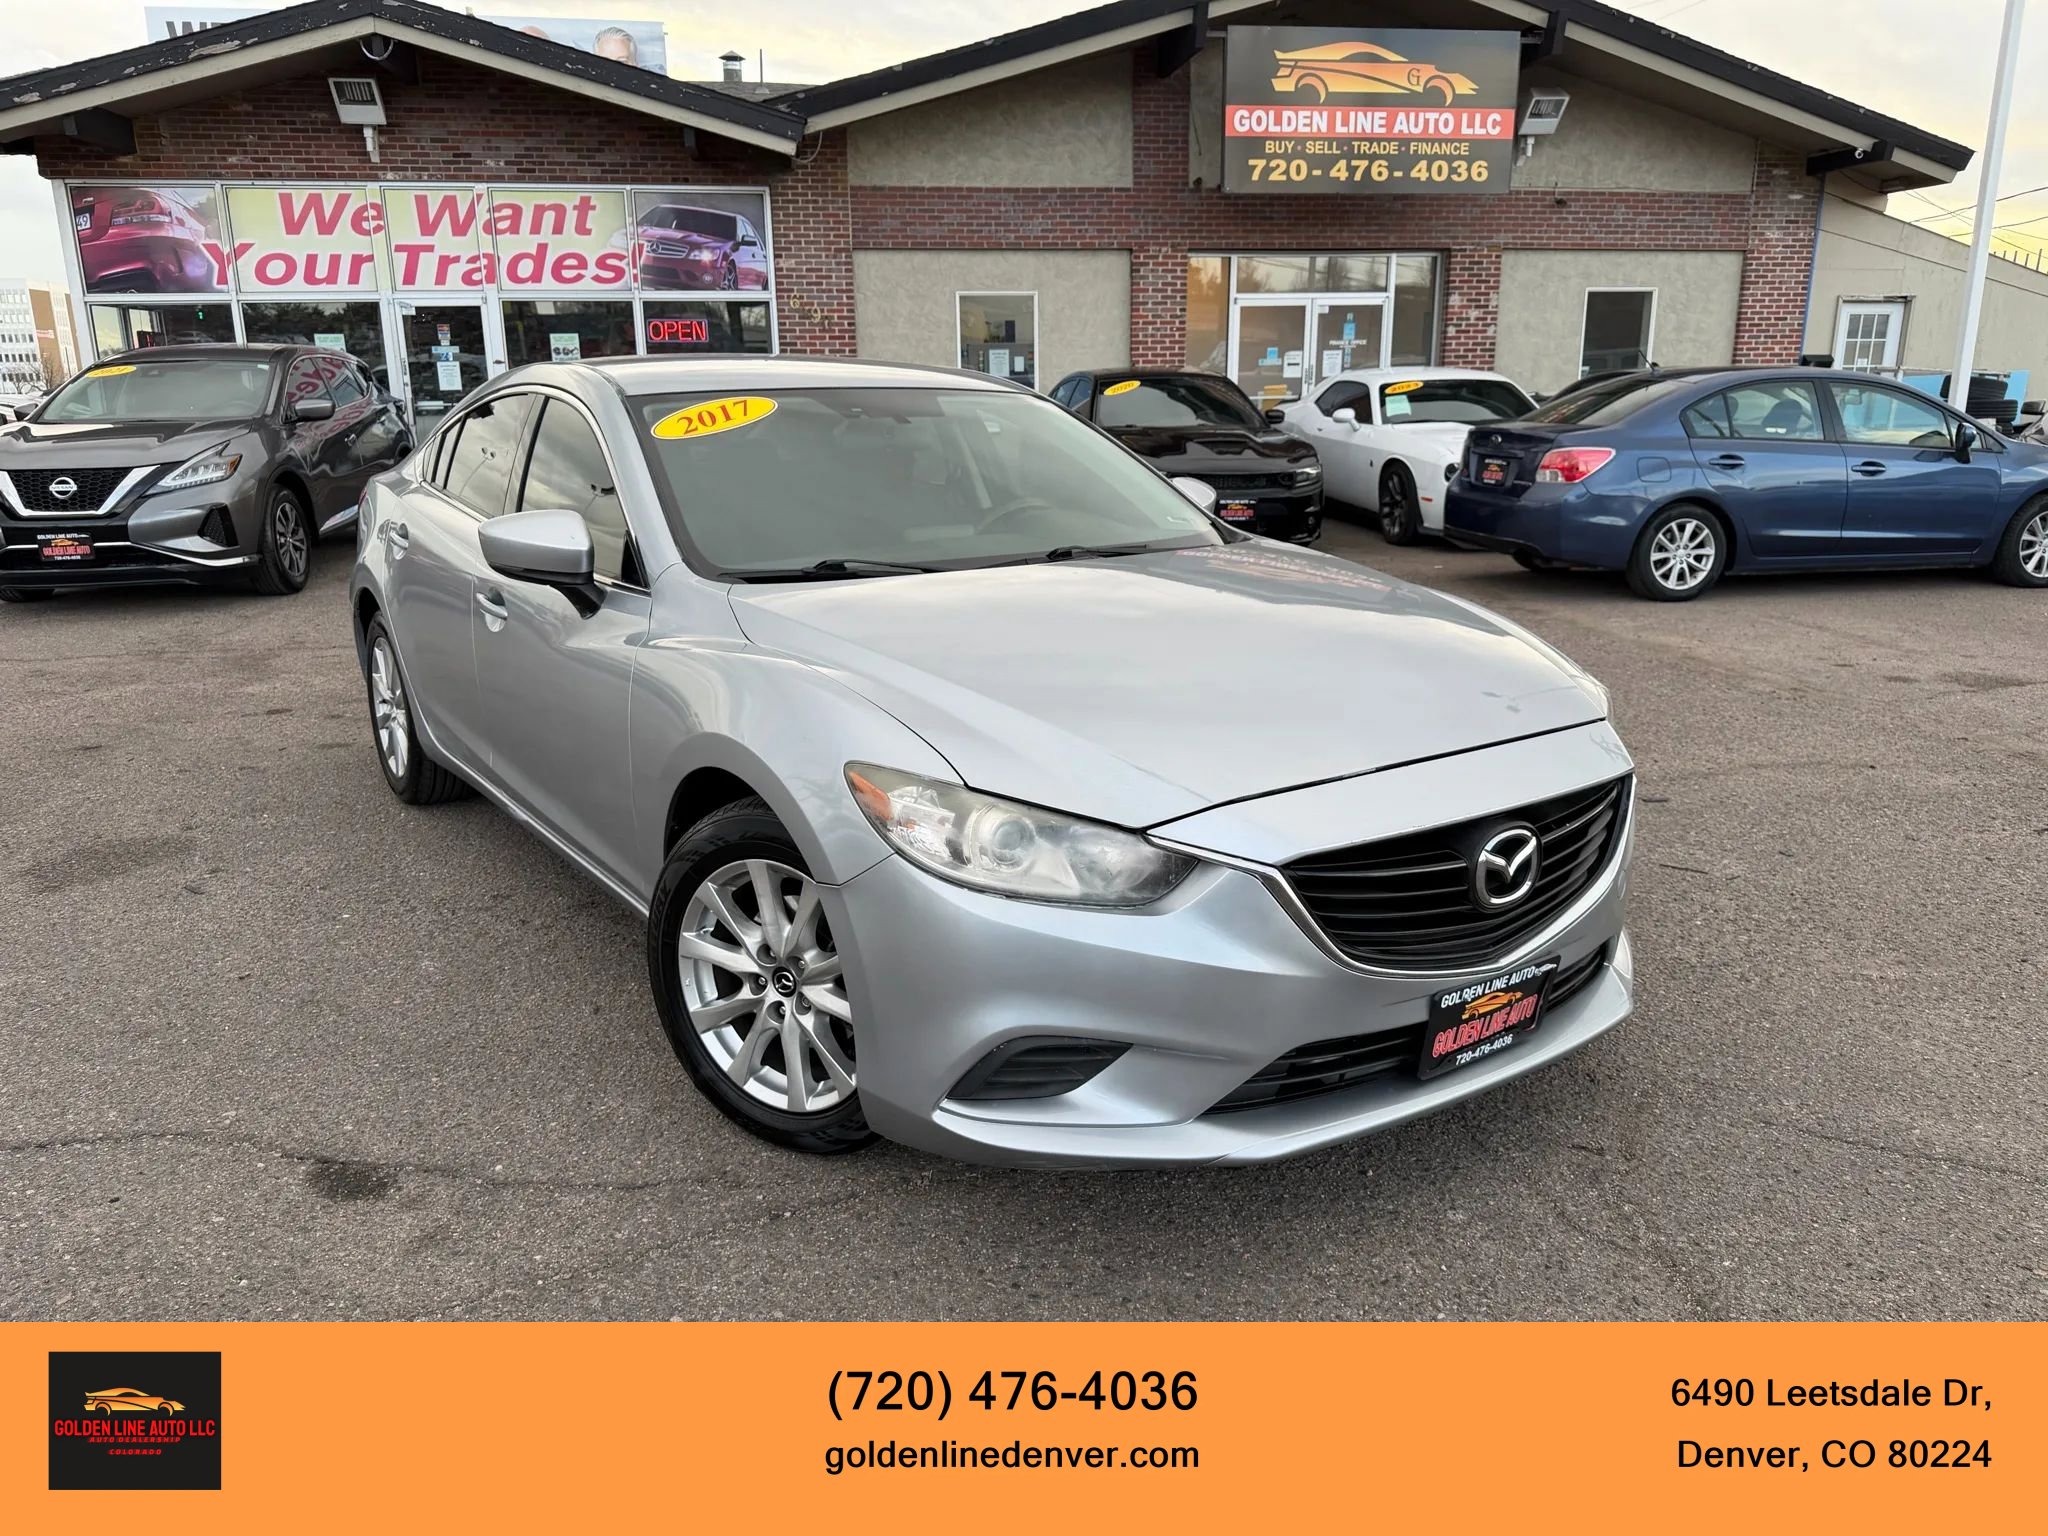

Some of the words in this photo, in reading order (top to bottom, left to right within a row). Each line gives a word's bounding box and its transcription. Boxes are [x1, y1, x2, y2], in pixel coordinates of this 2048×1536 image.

[1407, 67, 1422, 87] G
[1233, 109, 1329, 134] GOLDEN
[1335, 111, 1388, 134] LINE
[1393, 112, 1455, 135] AUTO
[1461, 113, 1503, 136] LLC
[1265, 140, 1295, 154] BUY
[1305, 141, 1341, 154] SELL
[1352, 141, 1399, 155] TRADE
[1409, 142, 1470, 155] FINANCE
[278, 192, 385, 237] We
[413, 193, 598, 238] Want
[202, 242, 375, 287] Your
[393, 242, 645, 288] Trades!
[650, 320, 706, 342] OPEN
[677, 399, 748, 435] 2017
[1440, 983, 1484, 1008] GOLDEN
[1484, 975, 1508, 995] LINE
[1509, 965, 1536, 986] AUTO
[1432, 1019, 1484, 1057] GOLDEN
[1481, 1007, 1510, 1040] LINE
[1506, 994, 1537, 1027] AUTO
[1455, 1034, 1513, 1066] 720-476-4036
